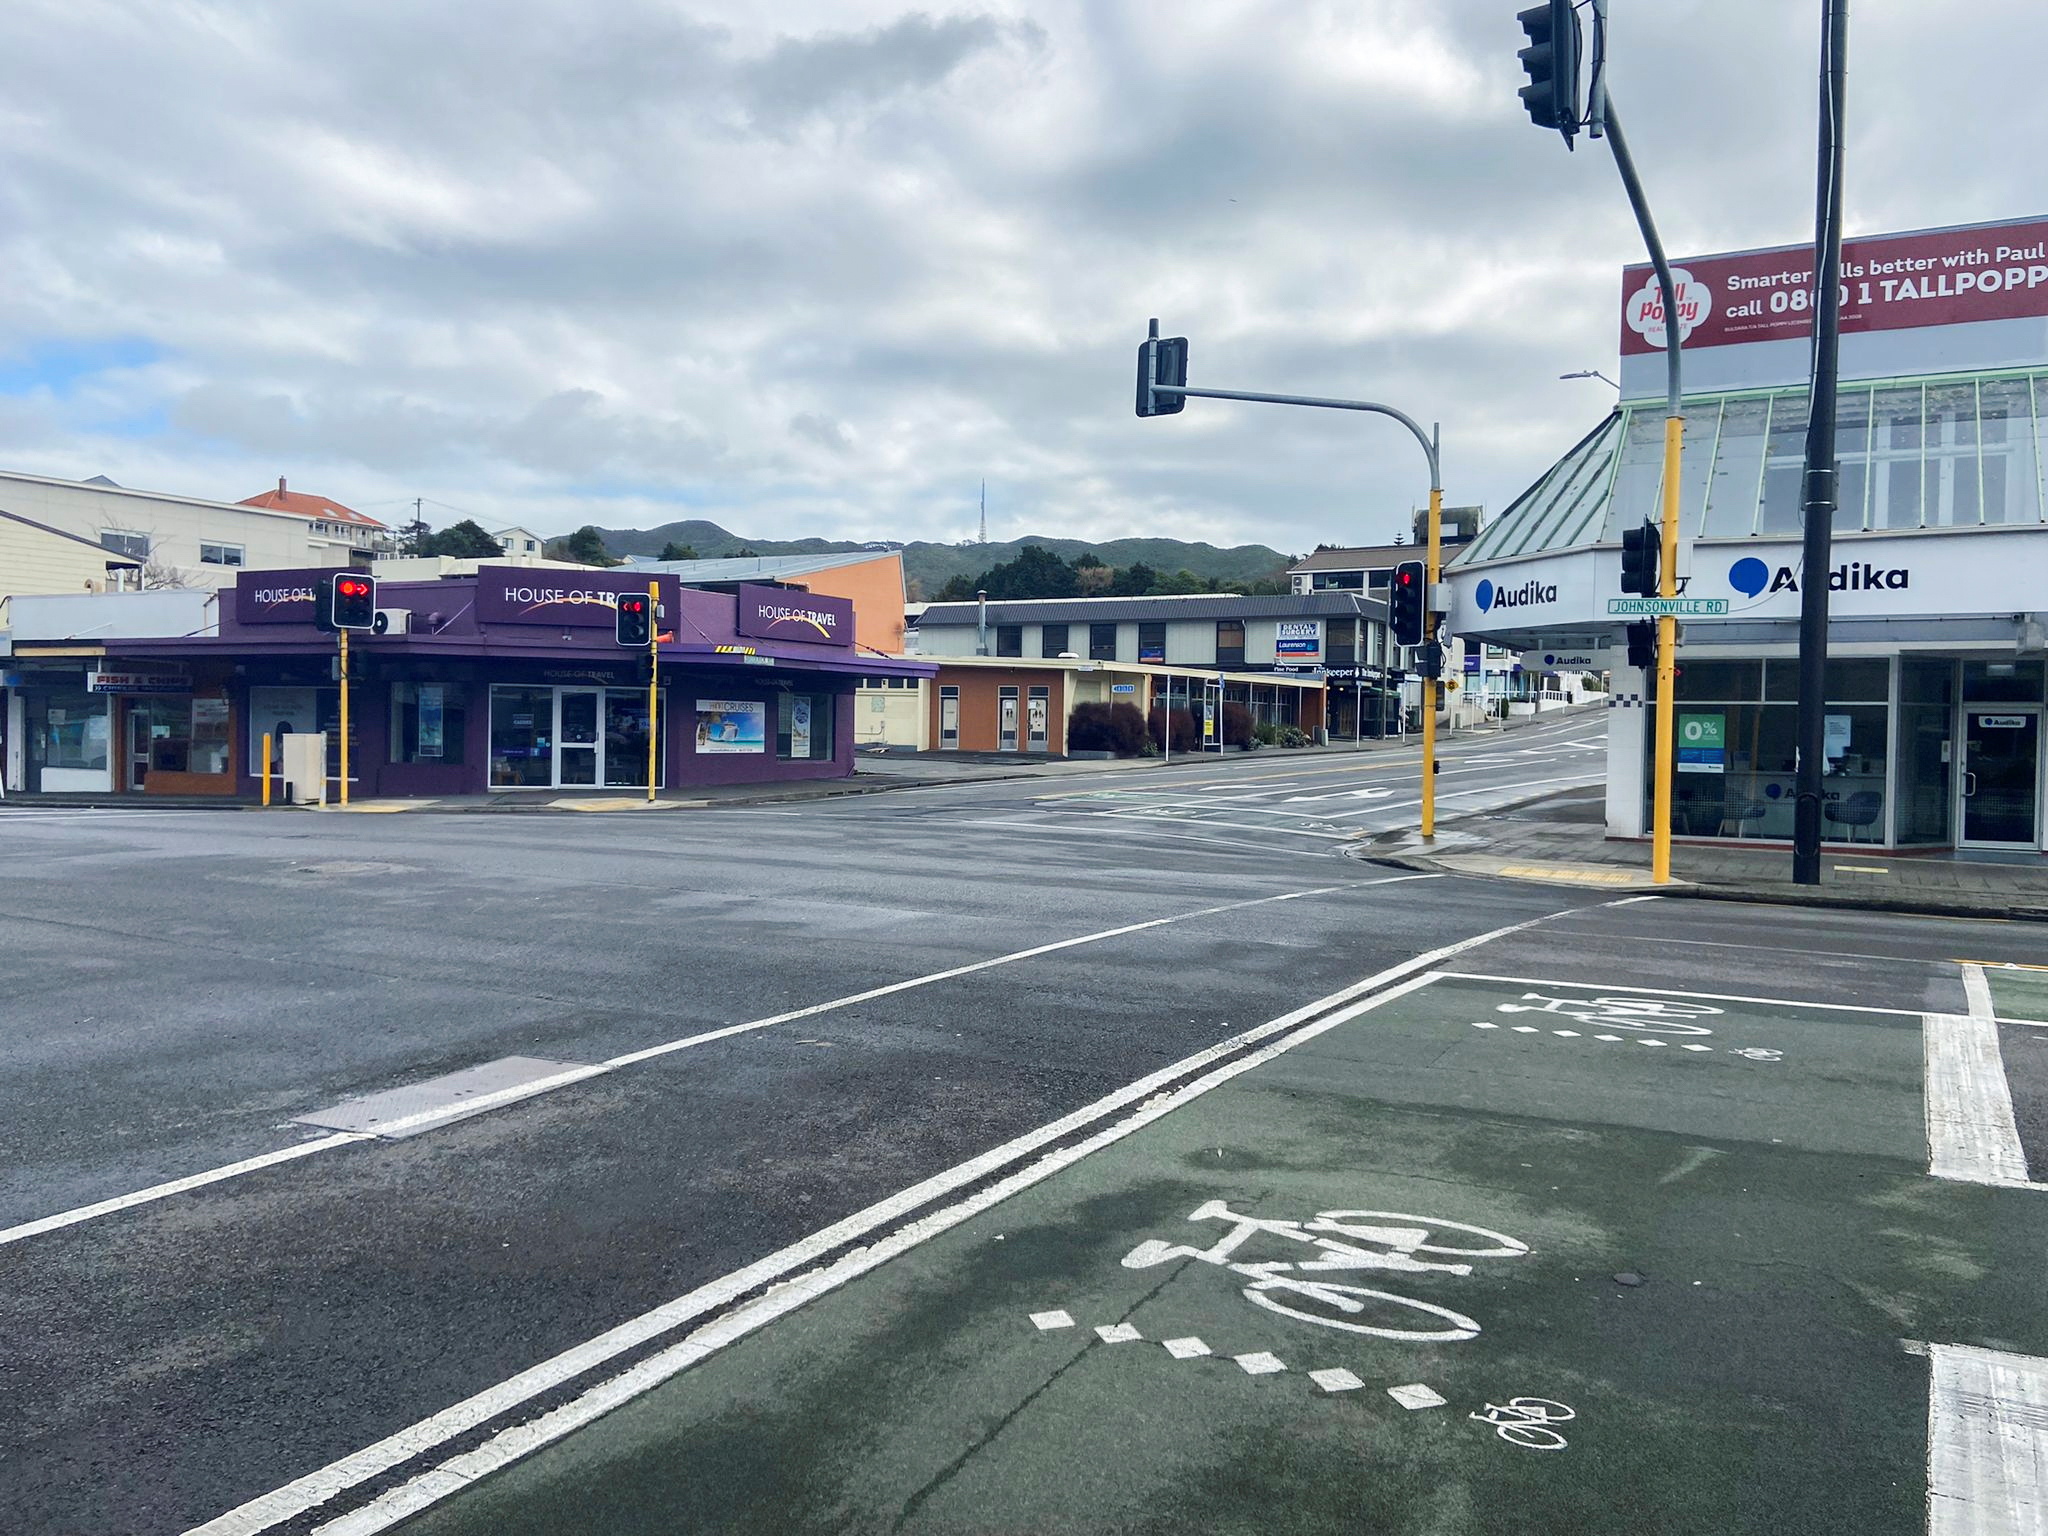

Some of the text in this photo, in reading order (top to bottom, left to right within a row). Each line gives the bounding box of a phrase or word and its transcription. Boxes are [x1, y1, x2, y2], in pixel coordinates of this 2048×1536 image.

[1727, 271, 1812, 291] Smarter
[1870, 259, 1937, 276] better
[1942, 248, 1989, 268] with
[1996, 242, 2046, 263] Paul
[1654, 283, 1685, 304] Tll
[1726, 300, 1763, 318] call
[1857, 282, 1873, 305] 1
[1880, 265, 2048, 302] TALLPOPP
[1769, 562, 1909, 593] Adika
[255, 588, 289, 603] HOUSE
[291, 588, 307, 602] OF
[505, 587, 564, 604] HOUSE
[569, 590, 593, 605] OF
[1493, 580, 1557, 609] Audika
[758, 605, 837, 627] HOUSE OF TRAVEL
[1614, 601, 1722, 613] JOHNSONVILLE RD
[1278, 641, 1307, 649] Laurenson
[1555, 655, 1592, 666] Audika
[97, 675, 129, 684] FISH
[725, 702, 754, 713] CRUISES
[1684, 721, 1717, 741] 0%
